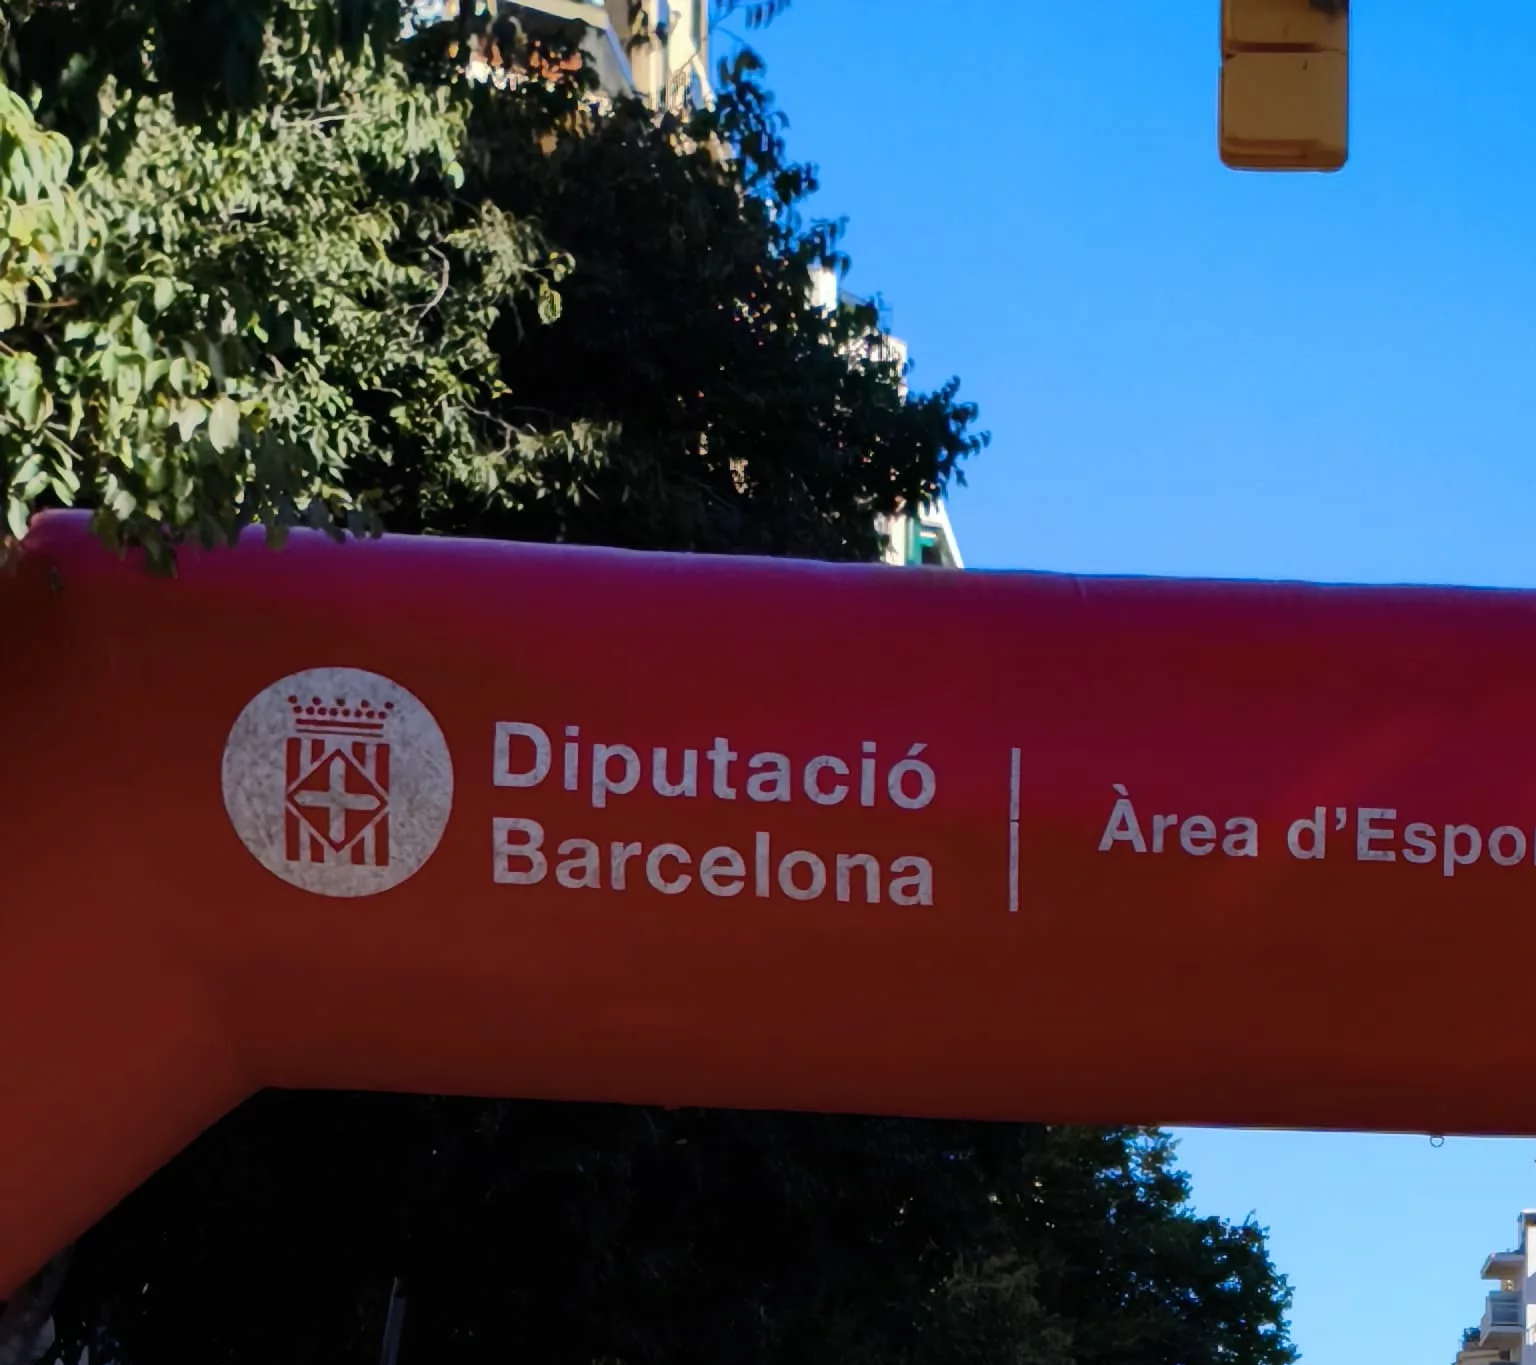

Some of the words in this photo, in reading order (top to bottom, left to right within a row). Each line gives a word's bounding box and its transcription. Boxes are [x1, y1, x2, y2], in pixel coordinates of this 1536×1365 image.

[492, 721, 936, 810] Diputació
[492, 817, 935, 906] Barcelona
[1100, 784, 1259, 857] Àrea
